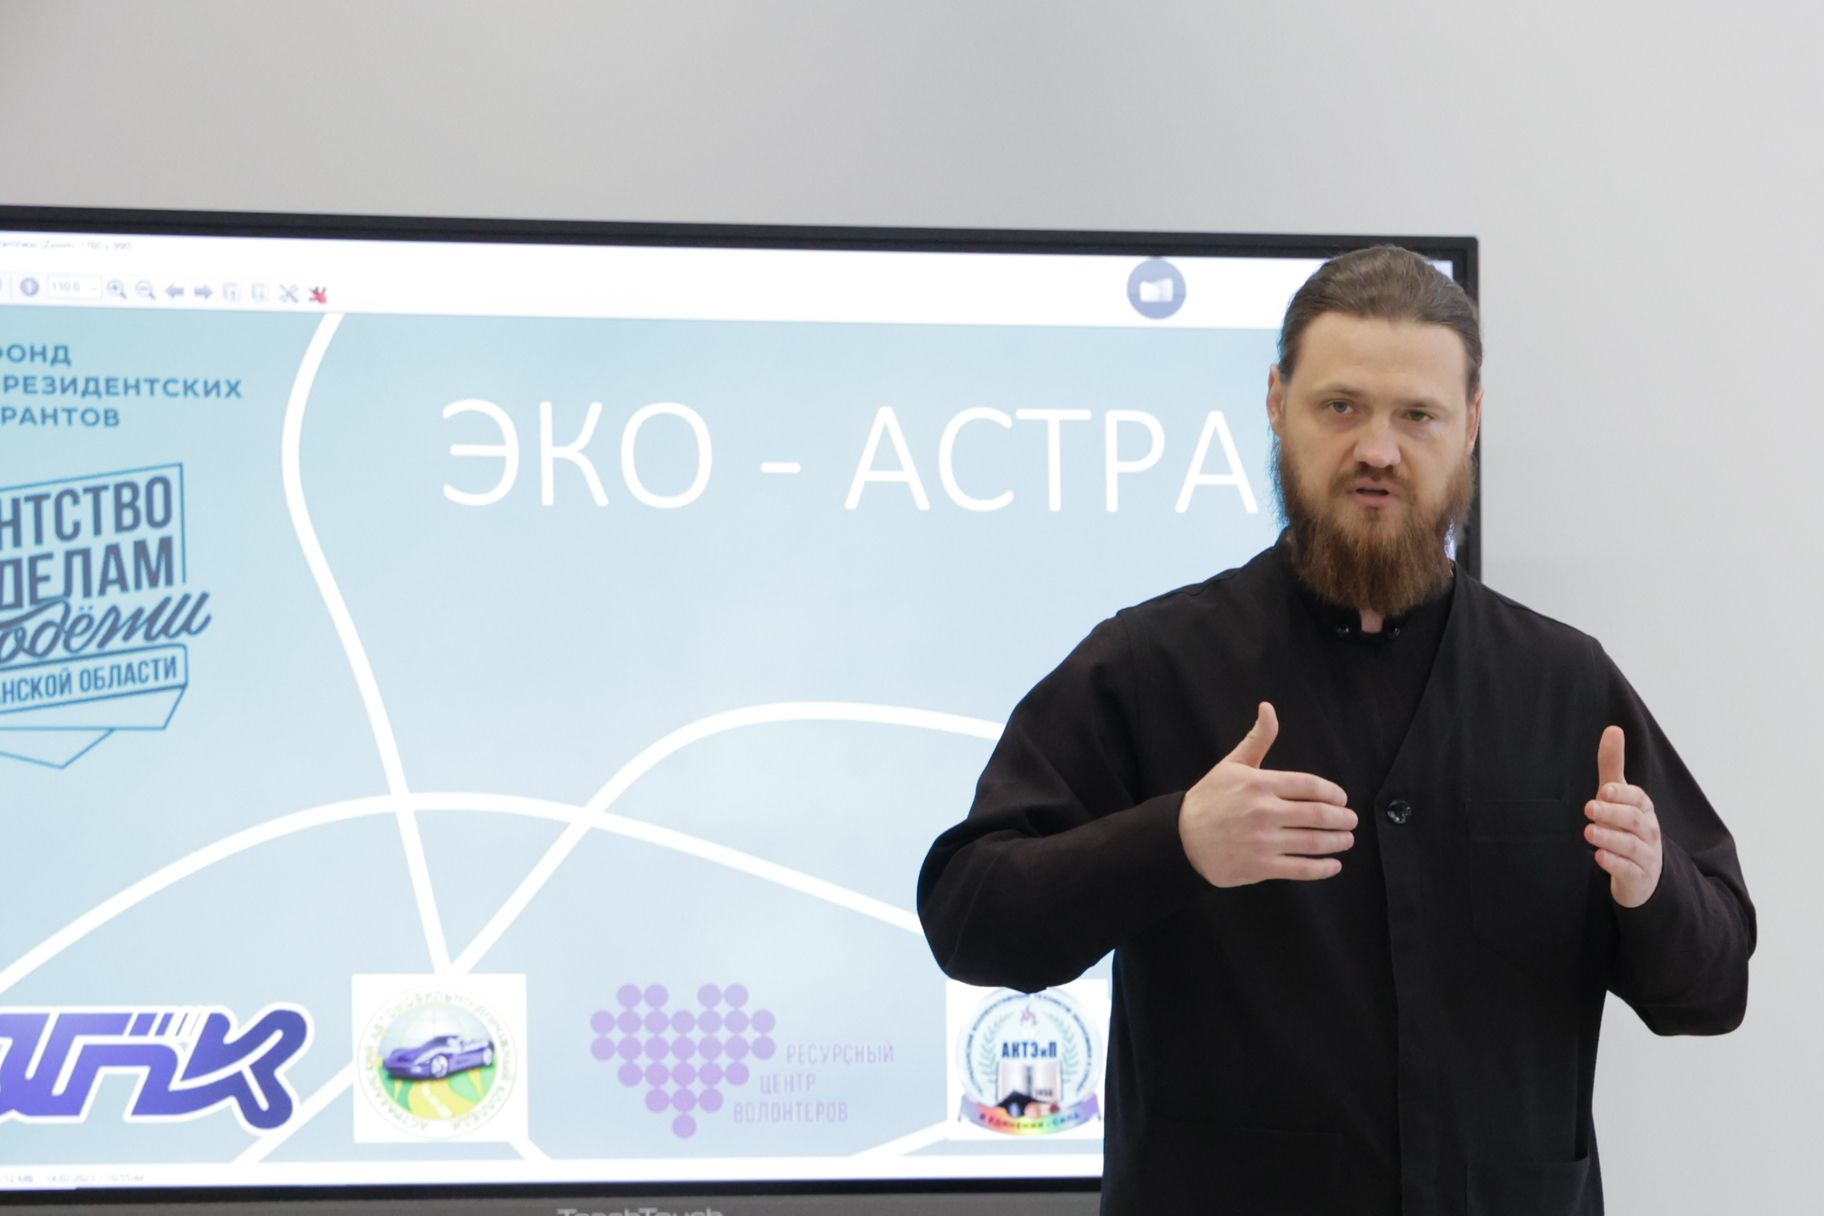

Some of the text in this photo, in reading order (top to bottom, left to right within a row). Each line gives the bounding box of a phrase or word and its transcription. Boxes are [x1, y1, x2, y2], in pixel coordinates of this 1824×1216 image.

[0, 344, 71, 367] ОНД
[442, 398, 1260, 515] ЭКО - АСТРА
[79, 655, 177, 692] ОБЛАСТИ
[786, 1042, 894, 1064] РЕСУРСНЫЙ
[760, 1073, 816, 1094] ЦЕНТР
[733, 1102, 848, 1123] ВОЛОНТЕРОВ
